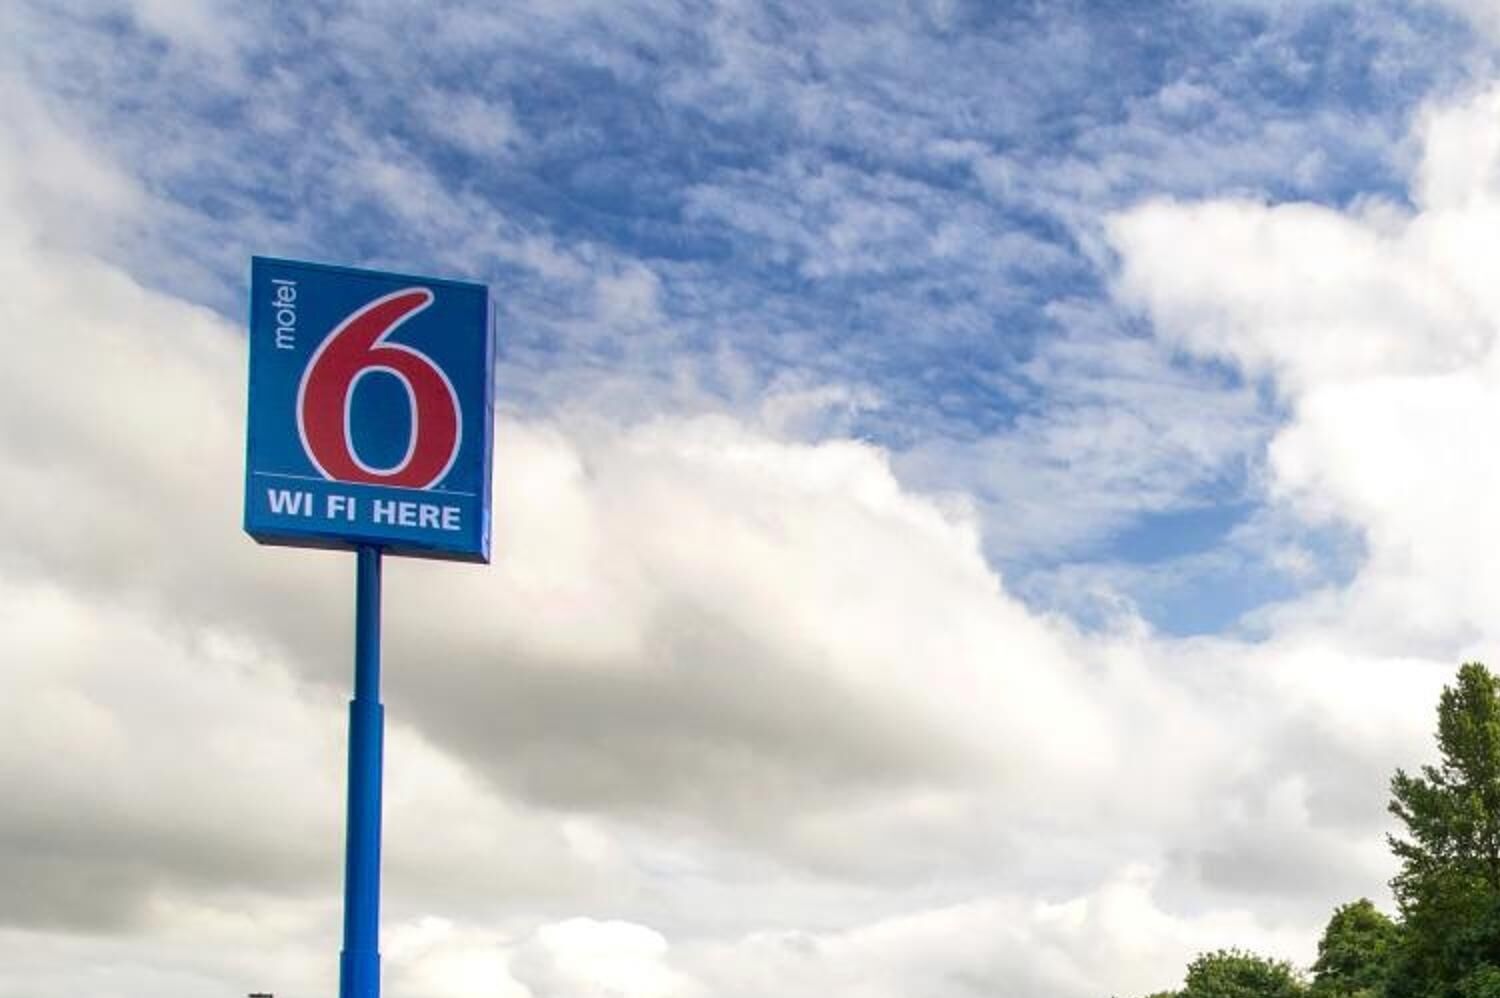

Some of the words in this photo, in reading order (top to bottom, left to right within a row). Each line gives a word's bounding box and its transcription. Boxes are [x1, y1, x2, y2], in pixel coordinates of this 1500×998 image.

[272, 279, 297, 349] motel
[296, 287, 462, 490] 6
[267, 489, 312, 516] WI
[327, 496, 355, 520] FI
[373, 500, 461, 530] HERE
